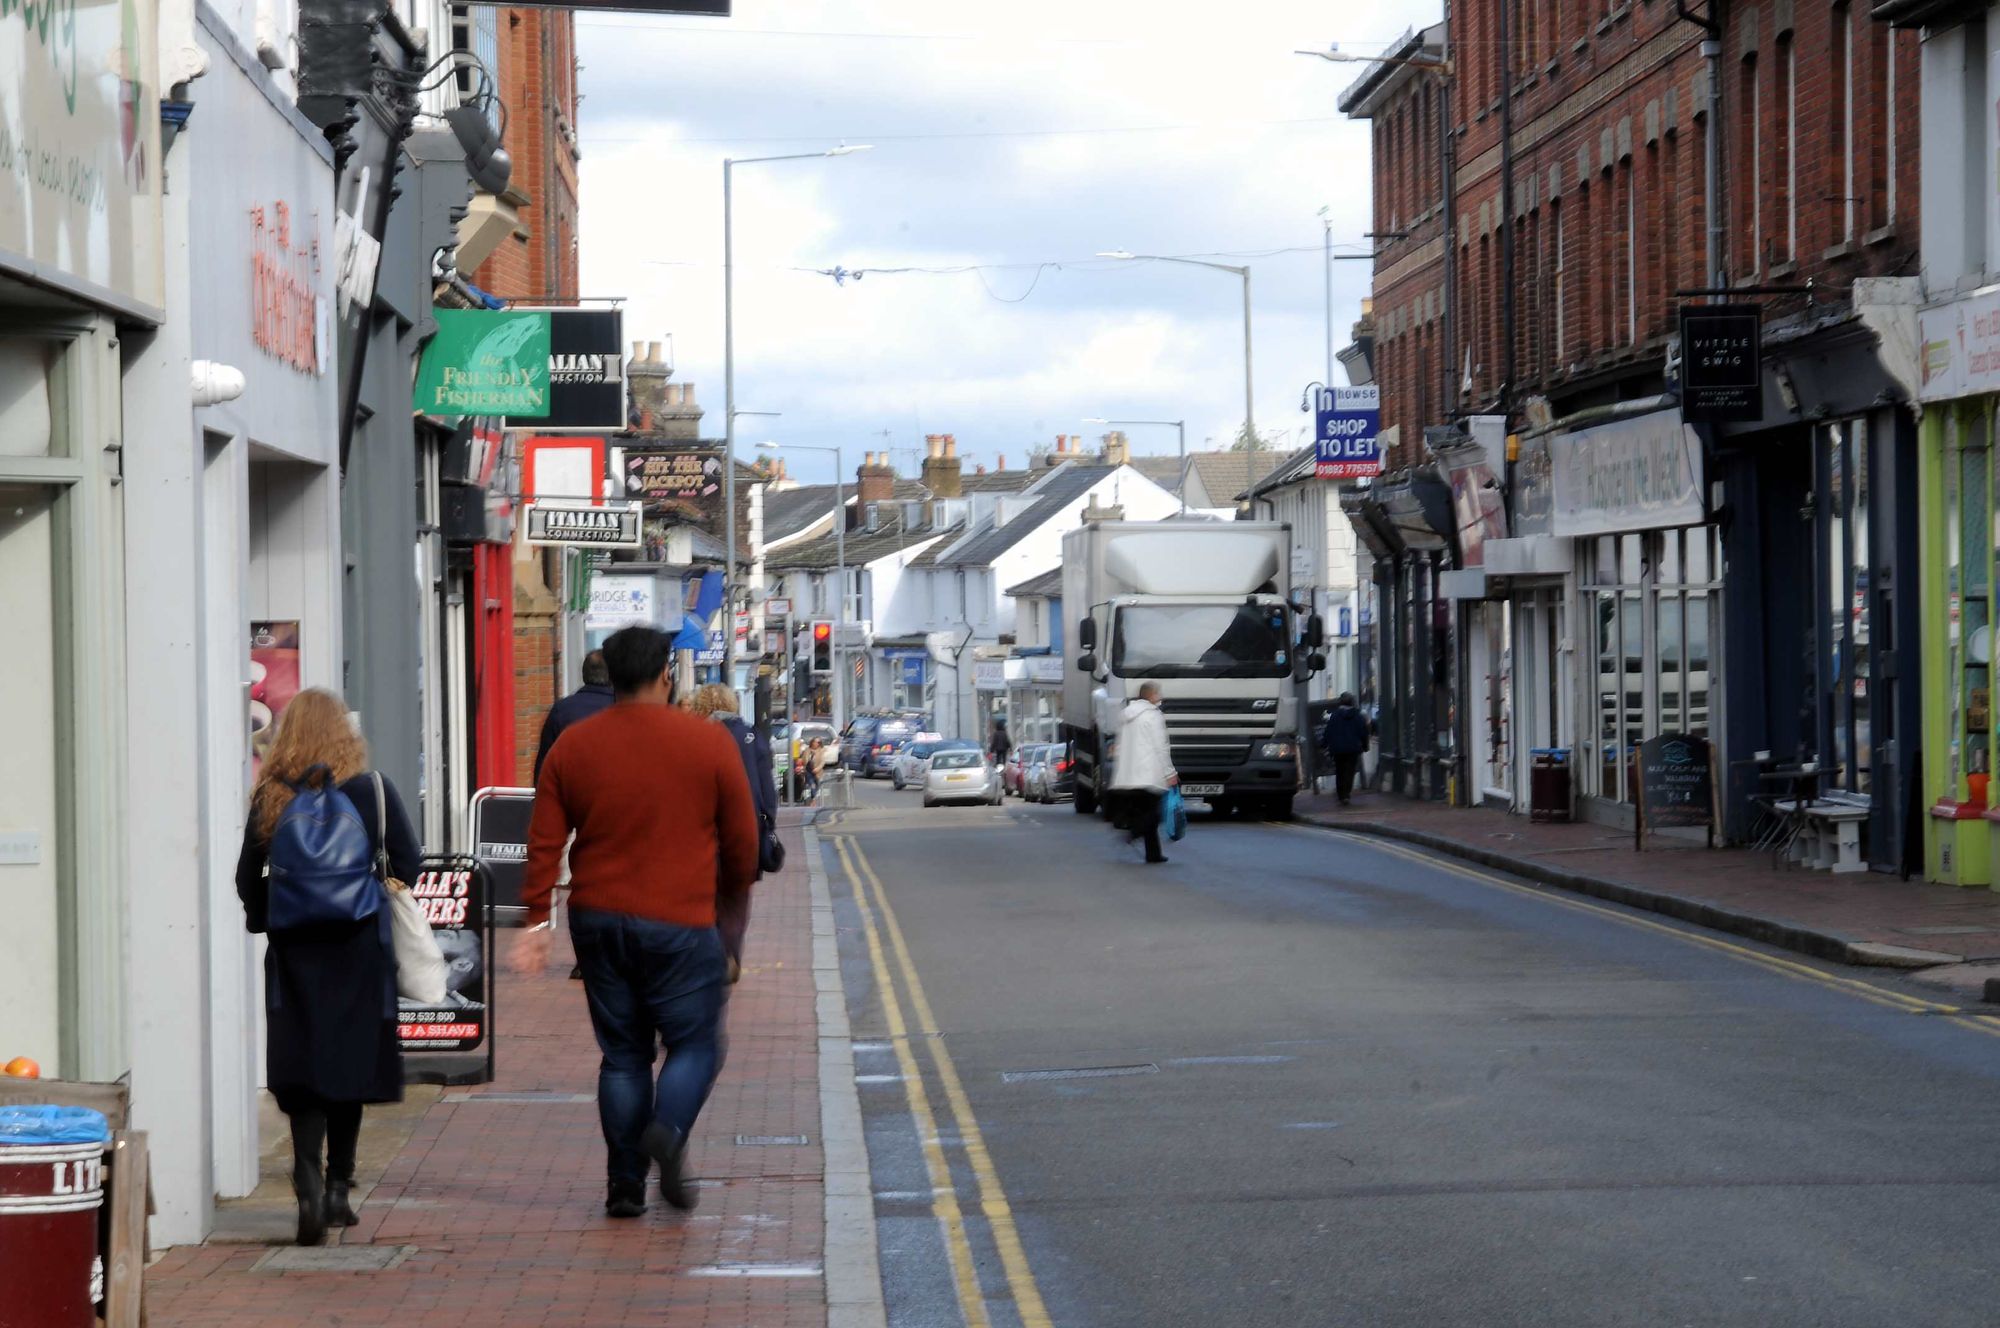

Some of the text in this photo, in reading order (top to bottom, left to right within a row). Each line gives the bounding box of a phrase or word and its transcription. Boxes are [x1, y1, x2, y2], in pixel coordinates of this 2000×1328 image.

[1694, 338, 1749, 348] VITTLE
[1703, 356, 1741, 365] SWIG
[443, 367, 537, 388] FRIENDLY
[434, 386, 545, 408] FISHERMAN
[1337, 388, 1377, 399] howse
[1327, 419, 1367, 436] SHOP
[1319, 438, 1376, 457] TO LET
[673, 460, 703, 475] THE
[641, 474, 706, 493] JACKPOT
[547, 511, 620, 528] ITALIAN
[546, 529, 620, 541] CONNECTION
[699, 651, 724, 660] WEAR
[1252, 700, 1276, 708] CF
[413, 1024, 427, 1037] A
[428, 1024, 477, 1037] SHAVE
